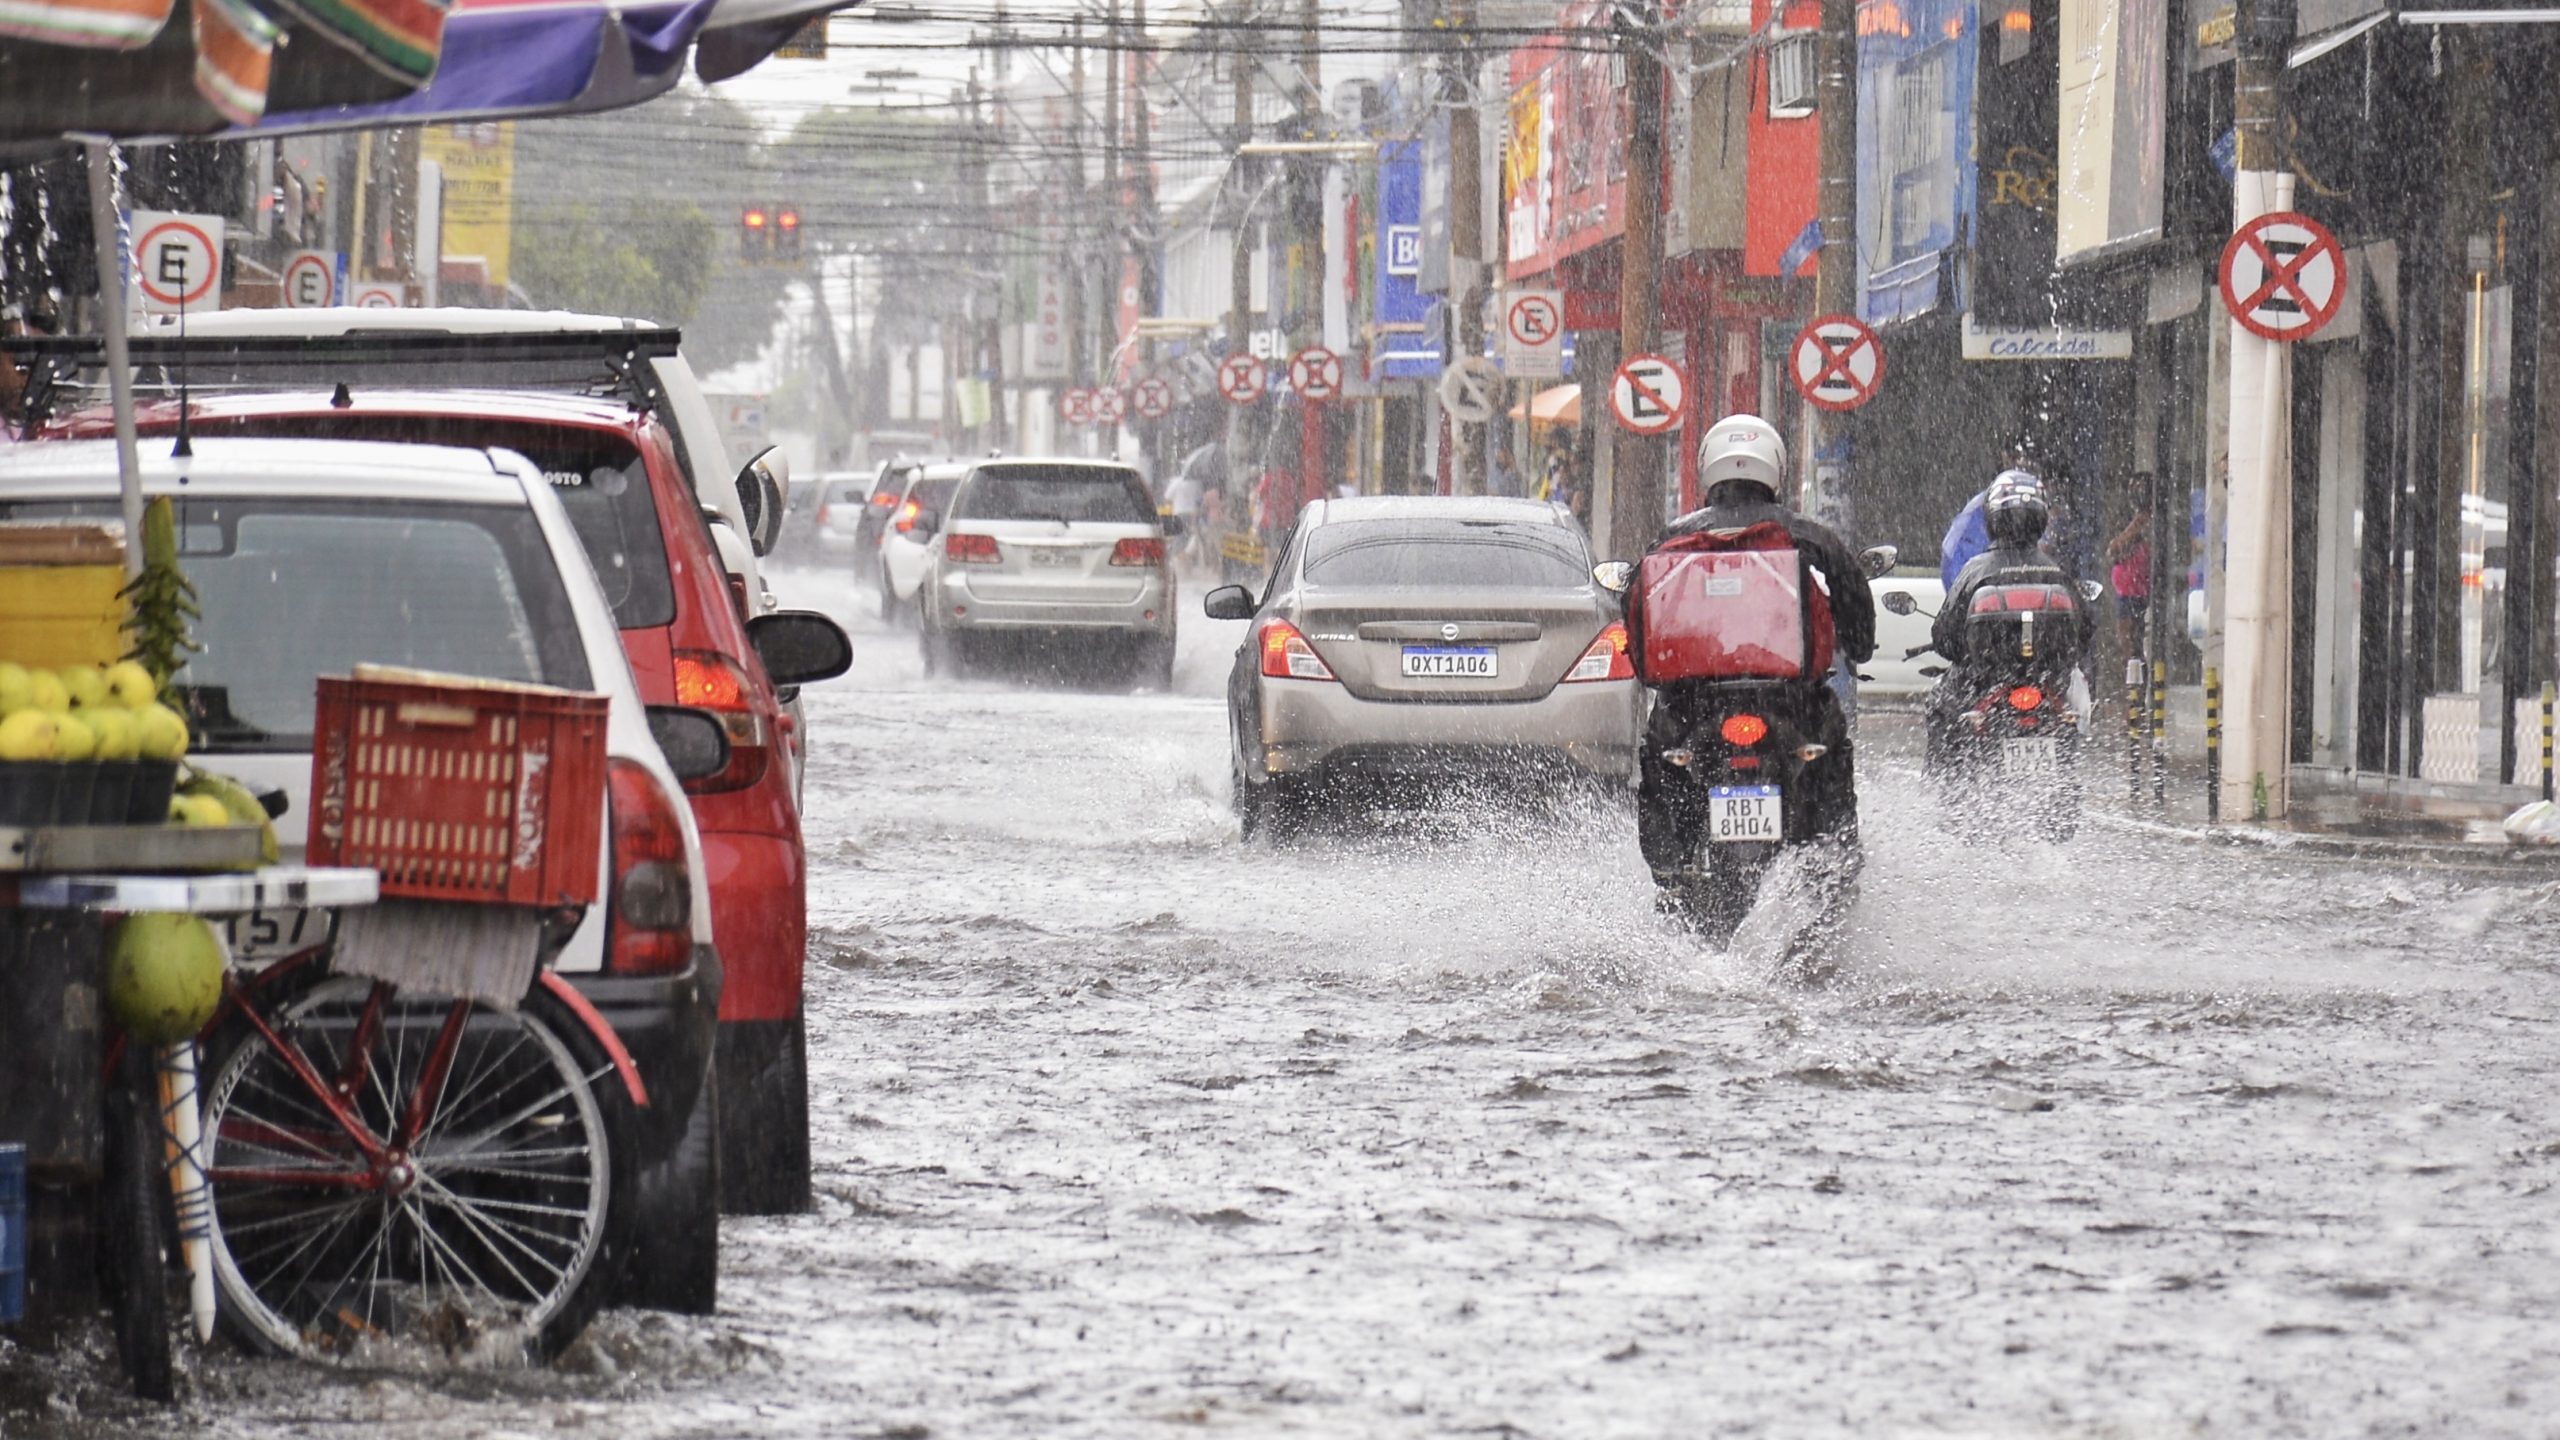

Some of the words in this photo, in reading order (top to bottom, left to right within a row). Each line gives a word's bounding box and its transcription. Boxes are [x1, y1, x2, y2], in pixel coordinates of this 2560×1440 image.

[159, 243, 190, 284] E
[300, 271, 317, 304] E
[1410, 655, 1489, 673] QXT1A06
[1726, 798, 1765, 817] RBT
[1720, 817, 1773, 836] 8H04
